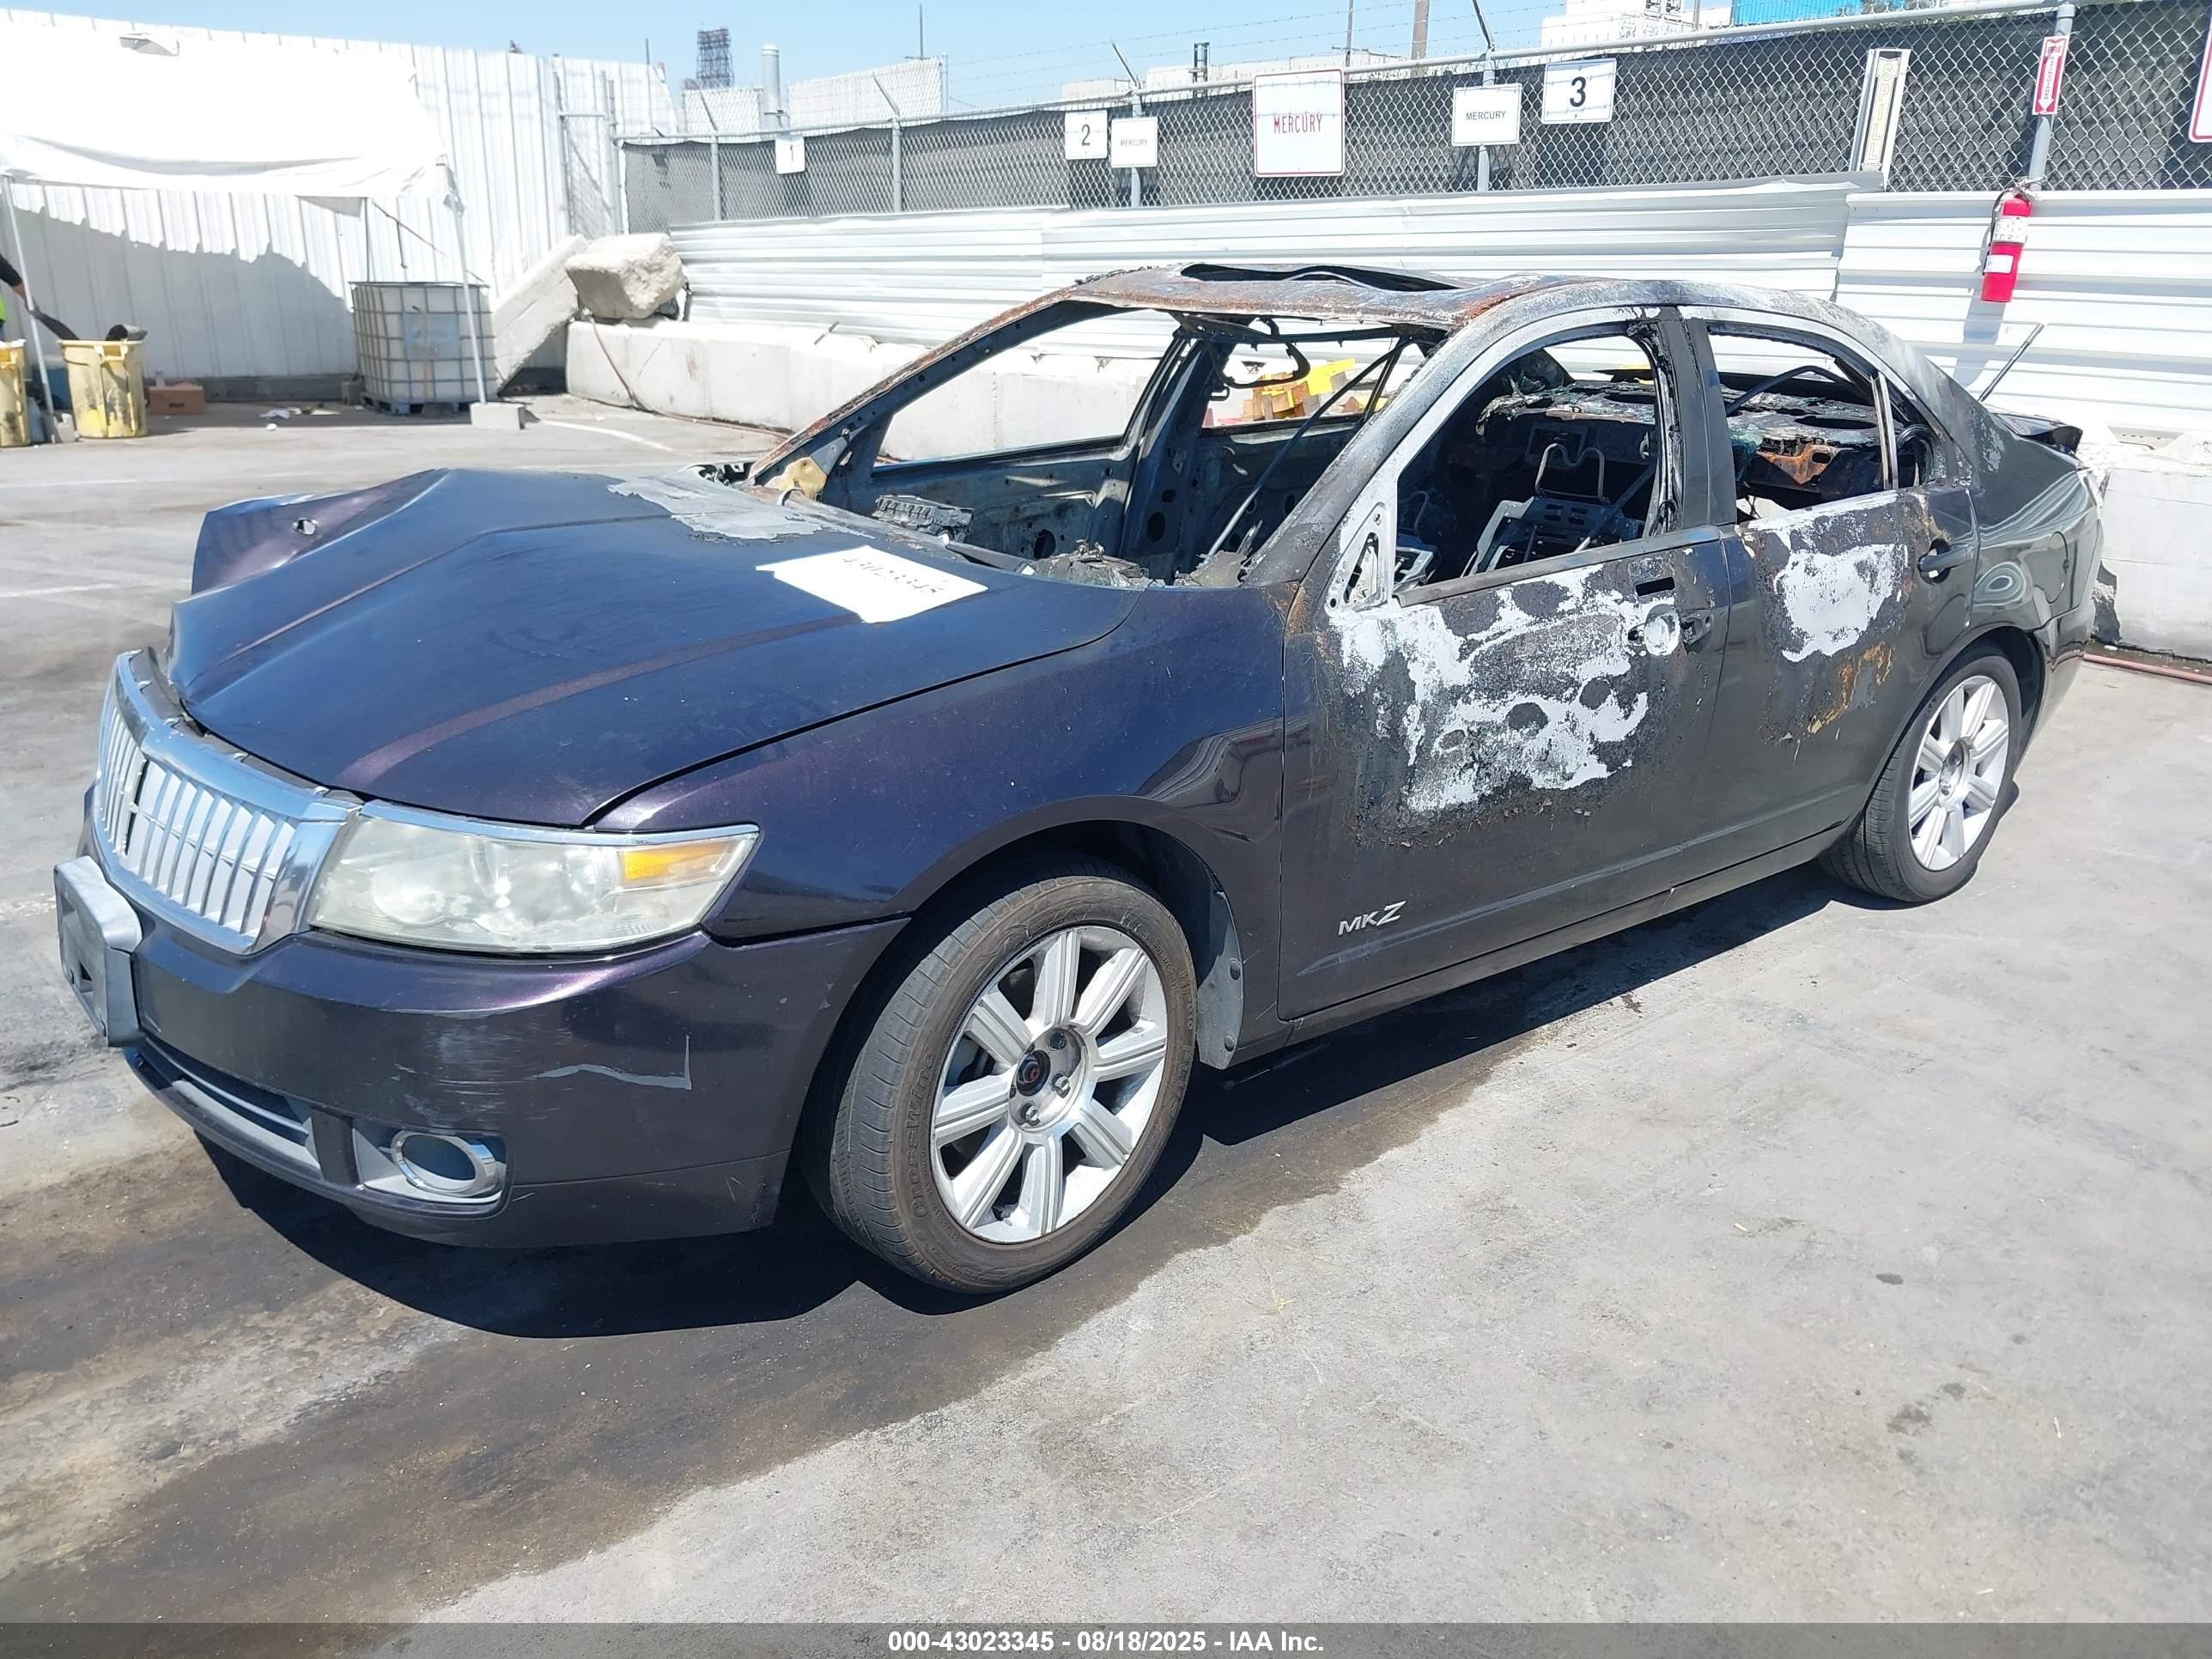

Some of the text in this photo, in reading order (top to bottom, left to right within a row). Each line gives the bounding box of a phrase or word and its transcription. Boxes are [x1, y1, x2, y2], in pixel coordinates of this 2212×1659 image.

[1569, 76, 1587, 107] 3
[1273, 113, 1323, 134] MERCURY
[1465, 110, 1507, 121] MERCURY
[1868, 63, 1893, 161] SPILL
[1081, 124, 1091, 147] 2
[1120, 138, 1148, 147] MERCURY
[1338, 900, 1407, 936] MKZ
